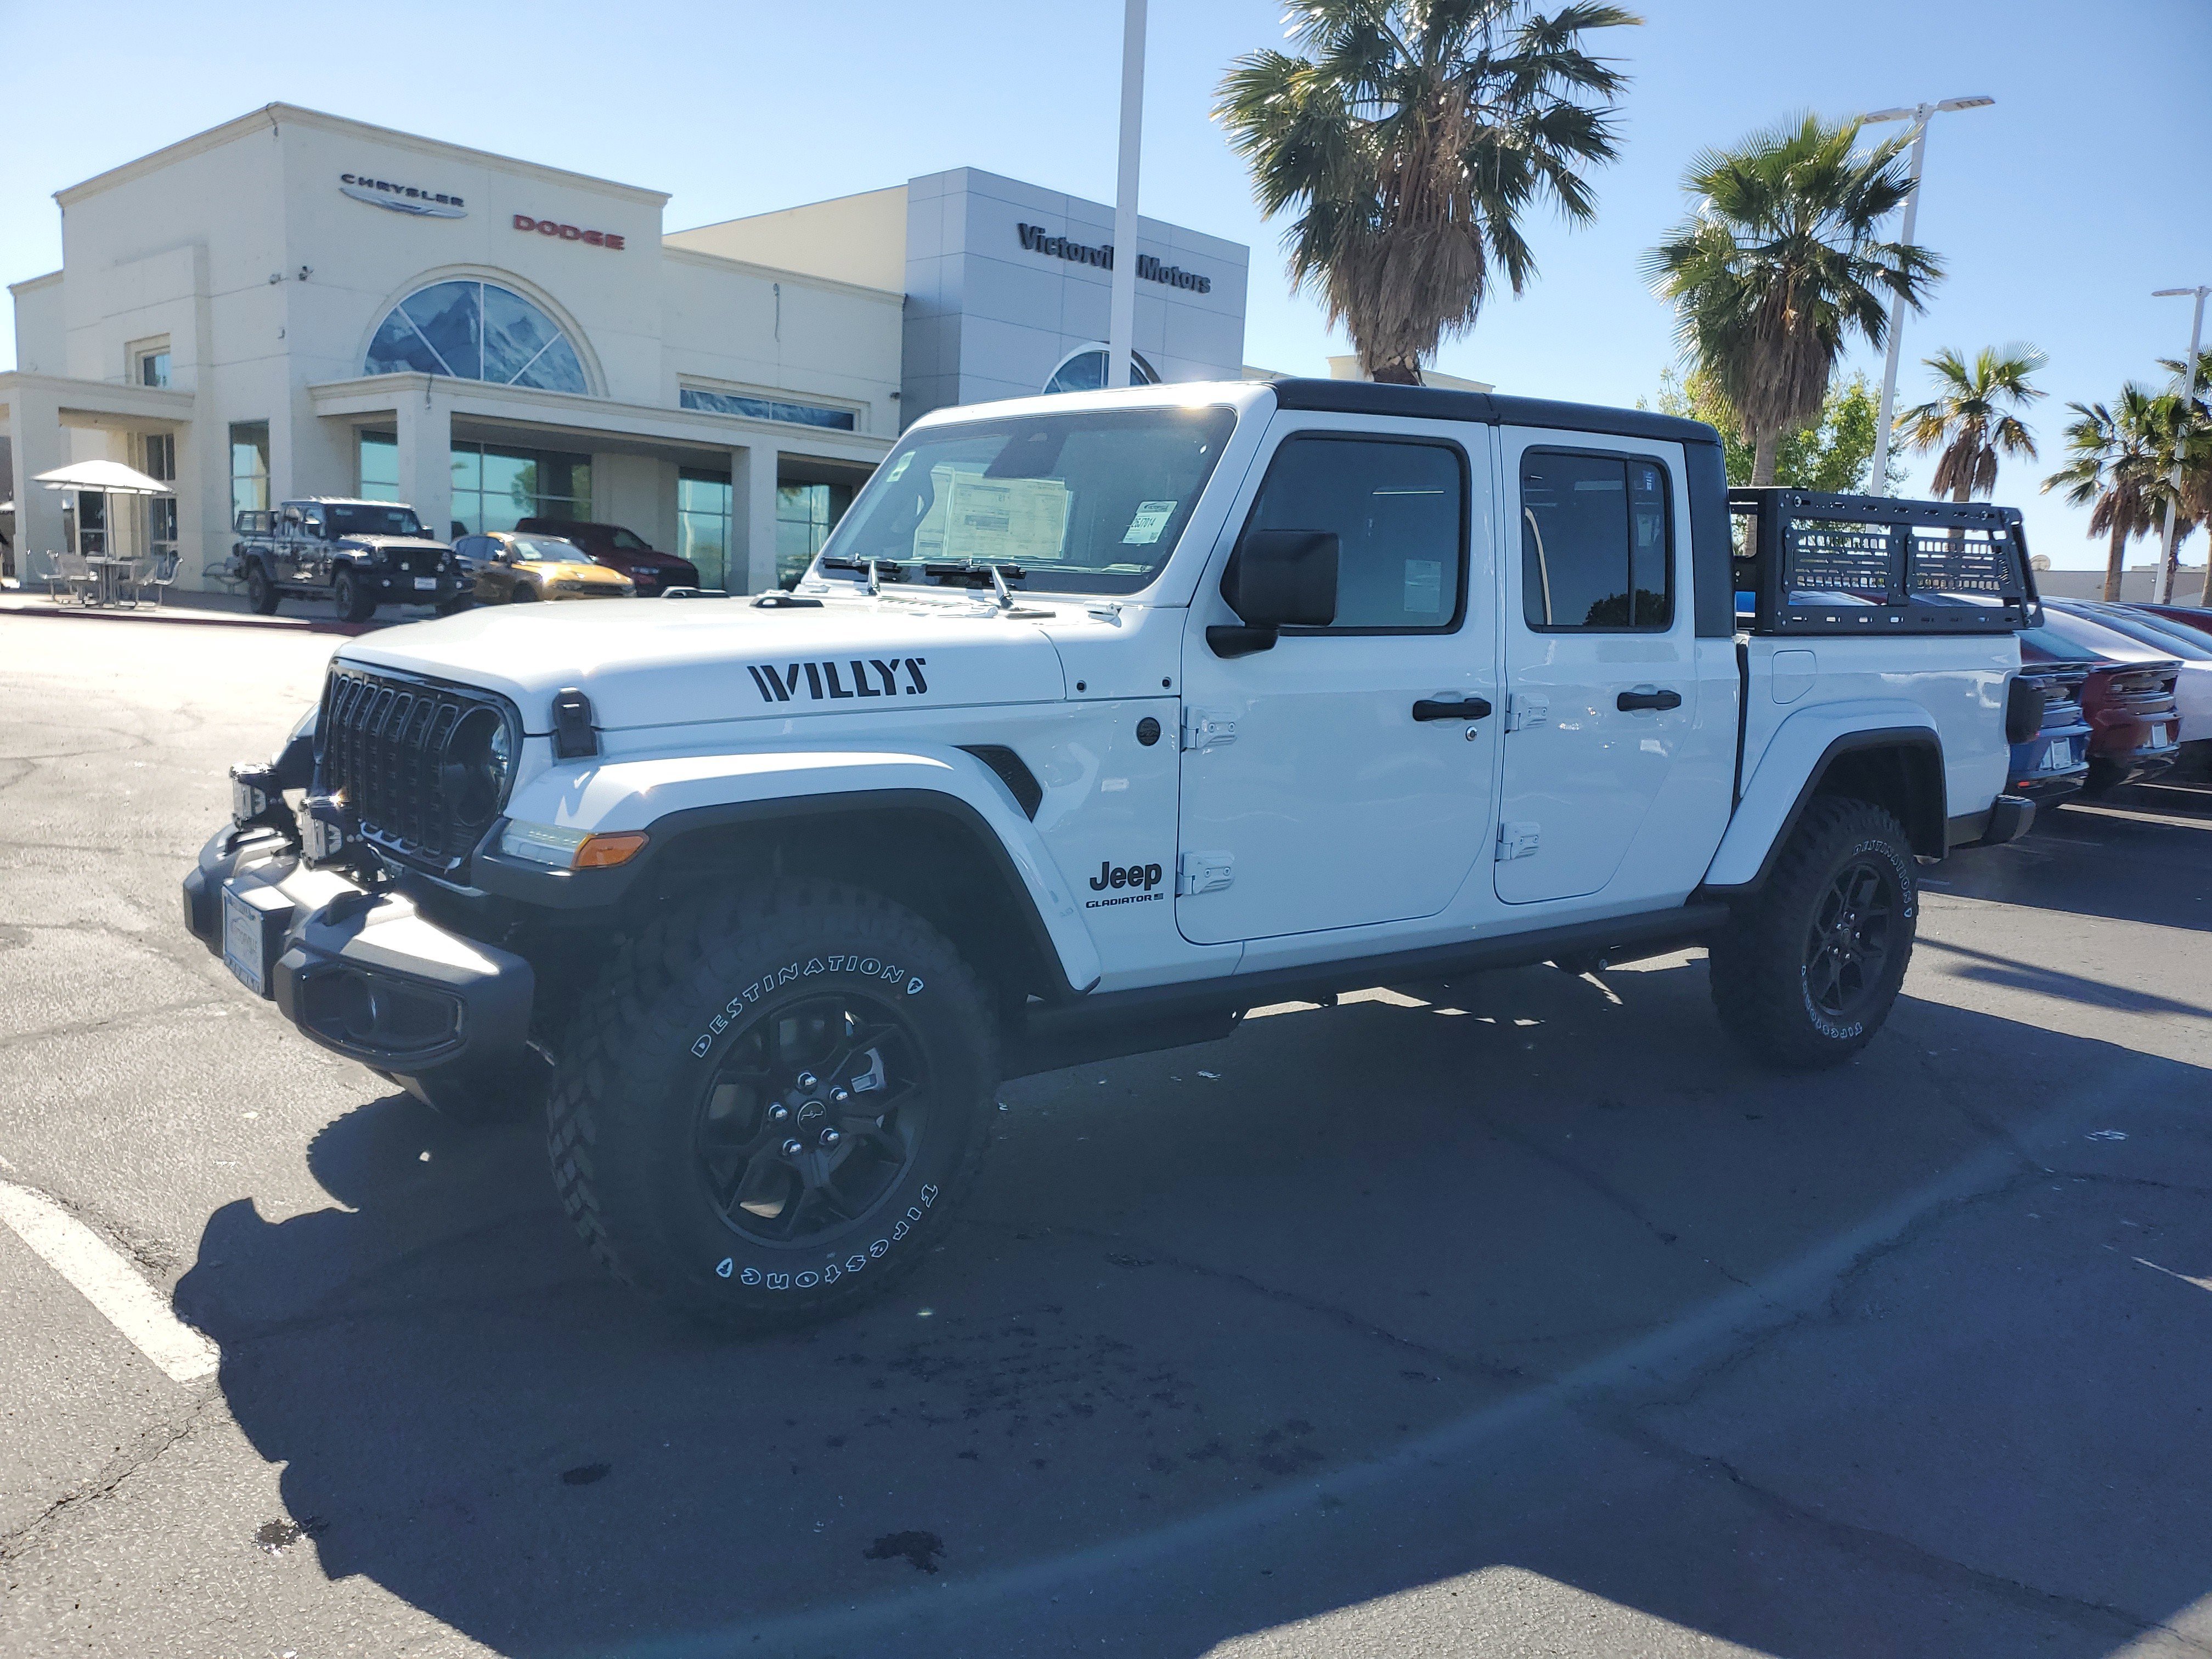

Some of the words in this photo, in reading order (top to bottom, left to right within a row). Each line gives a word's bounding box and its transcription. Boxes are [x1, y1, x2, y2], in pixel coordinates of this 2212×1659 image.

[341, 173, 464, 207] CHRYSLER
[513, 213, 625, 250] DODGE
[1017, 223, 1114, 270] Victorvi
[1136, 255, 1211, 294] Motors
[747, 658, 928, 702] WILLYS
[1090, 861, 1162, 891] Jeep
[1853, 839, 1912, 904] DESTINATION
[1086, 894, 1152, 909] GLADIATOR
[691, 955, 904, 1057] DESTINATION
[740, 1184, 938, 1290] Firestone
